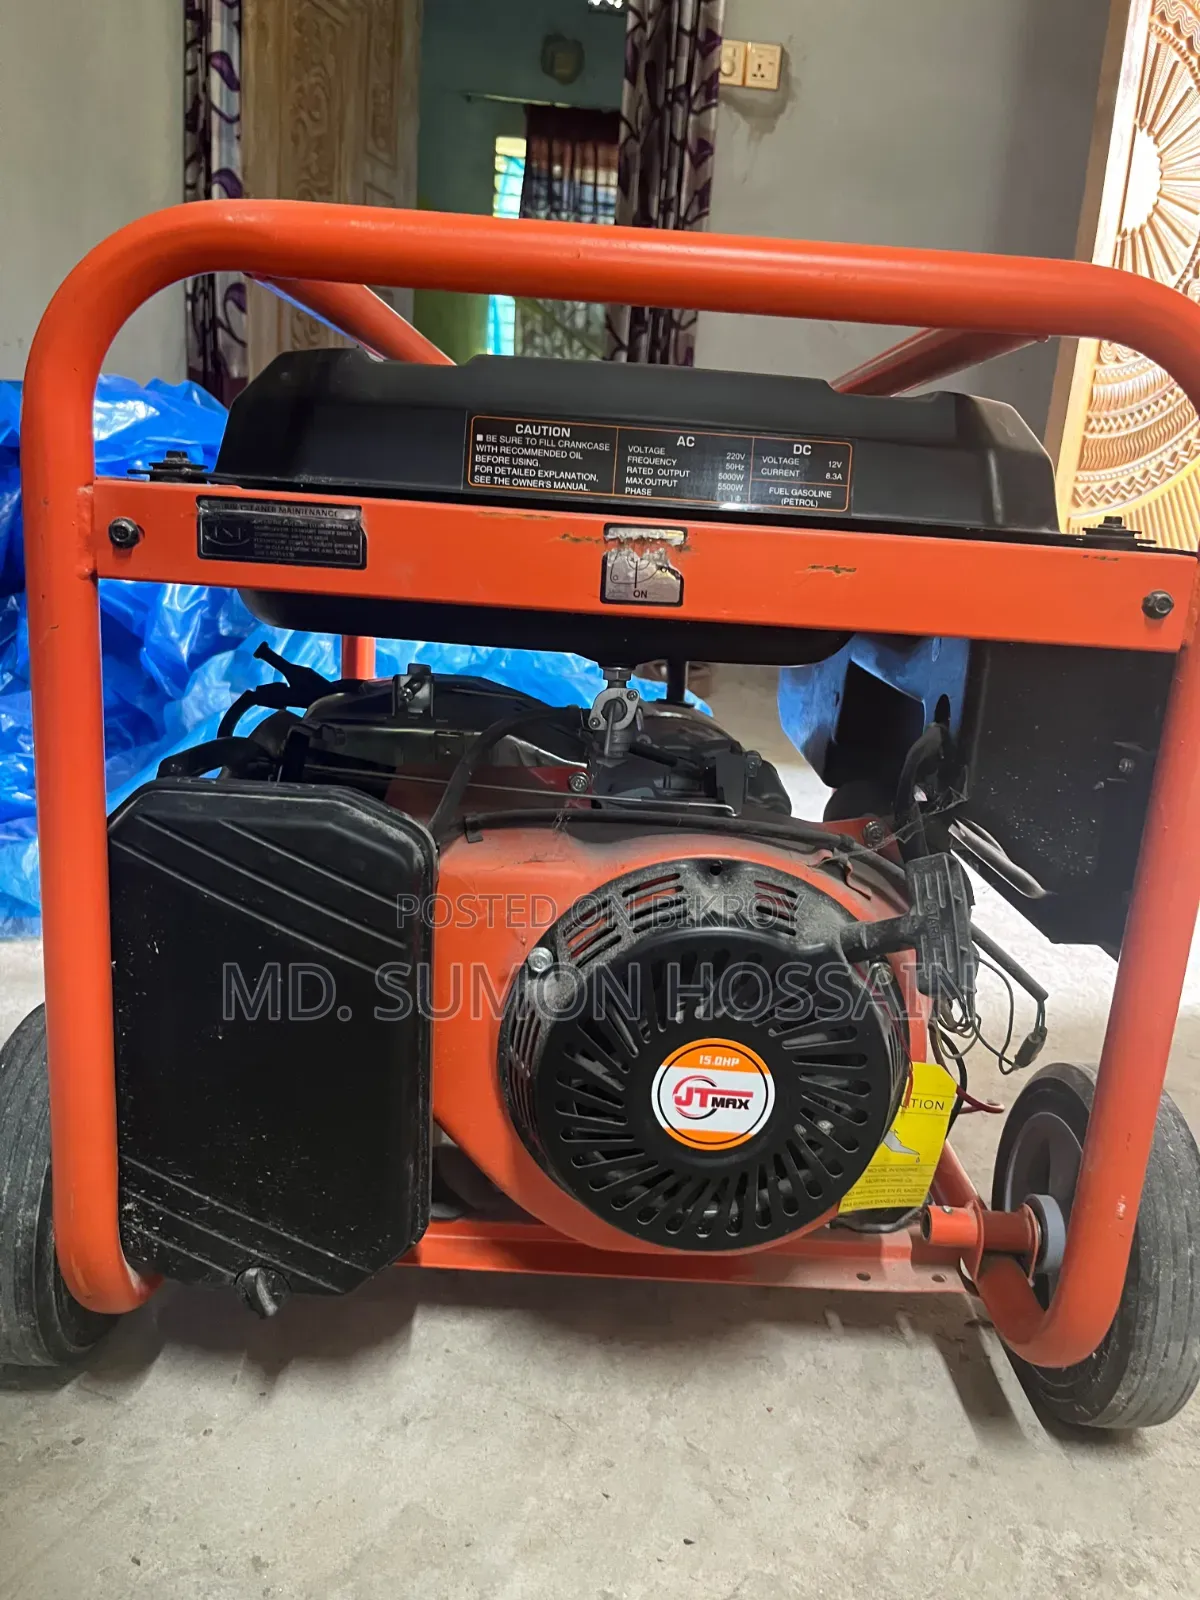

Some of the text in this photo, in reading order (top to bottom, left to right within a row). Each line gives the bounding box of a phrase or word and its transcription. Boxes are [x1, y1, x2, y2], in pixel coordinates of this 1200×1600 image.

[515, 423, 571, 438] CAUTION
[485, 434, 611, 451] BE SURE TO FILL CRANKCASE
[676, 436, 695, 447] AC
[476, 444, 583, 460] WITH RECOMMENDED OIL
[628, 445, 746, 461] VOLTAGE 220V
[793, 444, 812, 456] DC
[475, 455, 541, 467] BEFORE USING.
[627, 456, 745, 471] FREQUENCY 50Hz
[762, 456, 843, 469] VOLTAGE 12V
[474, 465, 493, 474] FOR
[494, 466, 536, 477] DETAILED
[626, 466, 745, 482] RATED OUTPUT 5000W
[761, 468, 801, 478] CURRENT
[474, 475, 591, 492] SEE THE OWNER'S MANUAL.
[717, 483, 743, 492] 5500W
[625, 486, 652, 496] PHASE
[768, 486, 832, 499] FUEL GASOLINE
[781, 496, 818, 508] (PETROL)
[633, 589, 648, 599] ON
[699, 1054, 740, 1067] 15.0HP
[907, 1098, 945, 1111] TION
